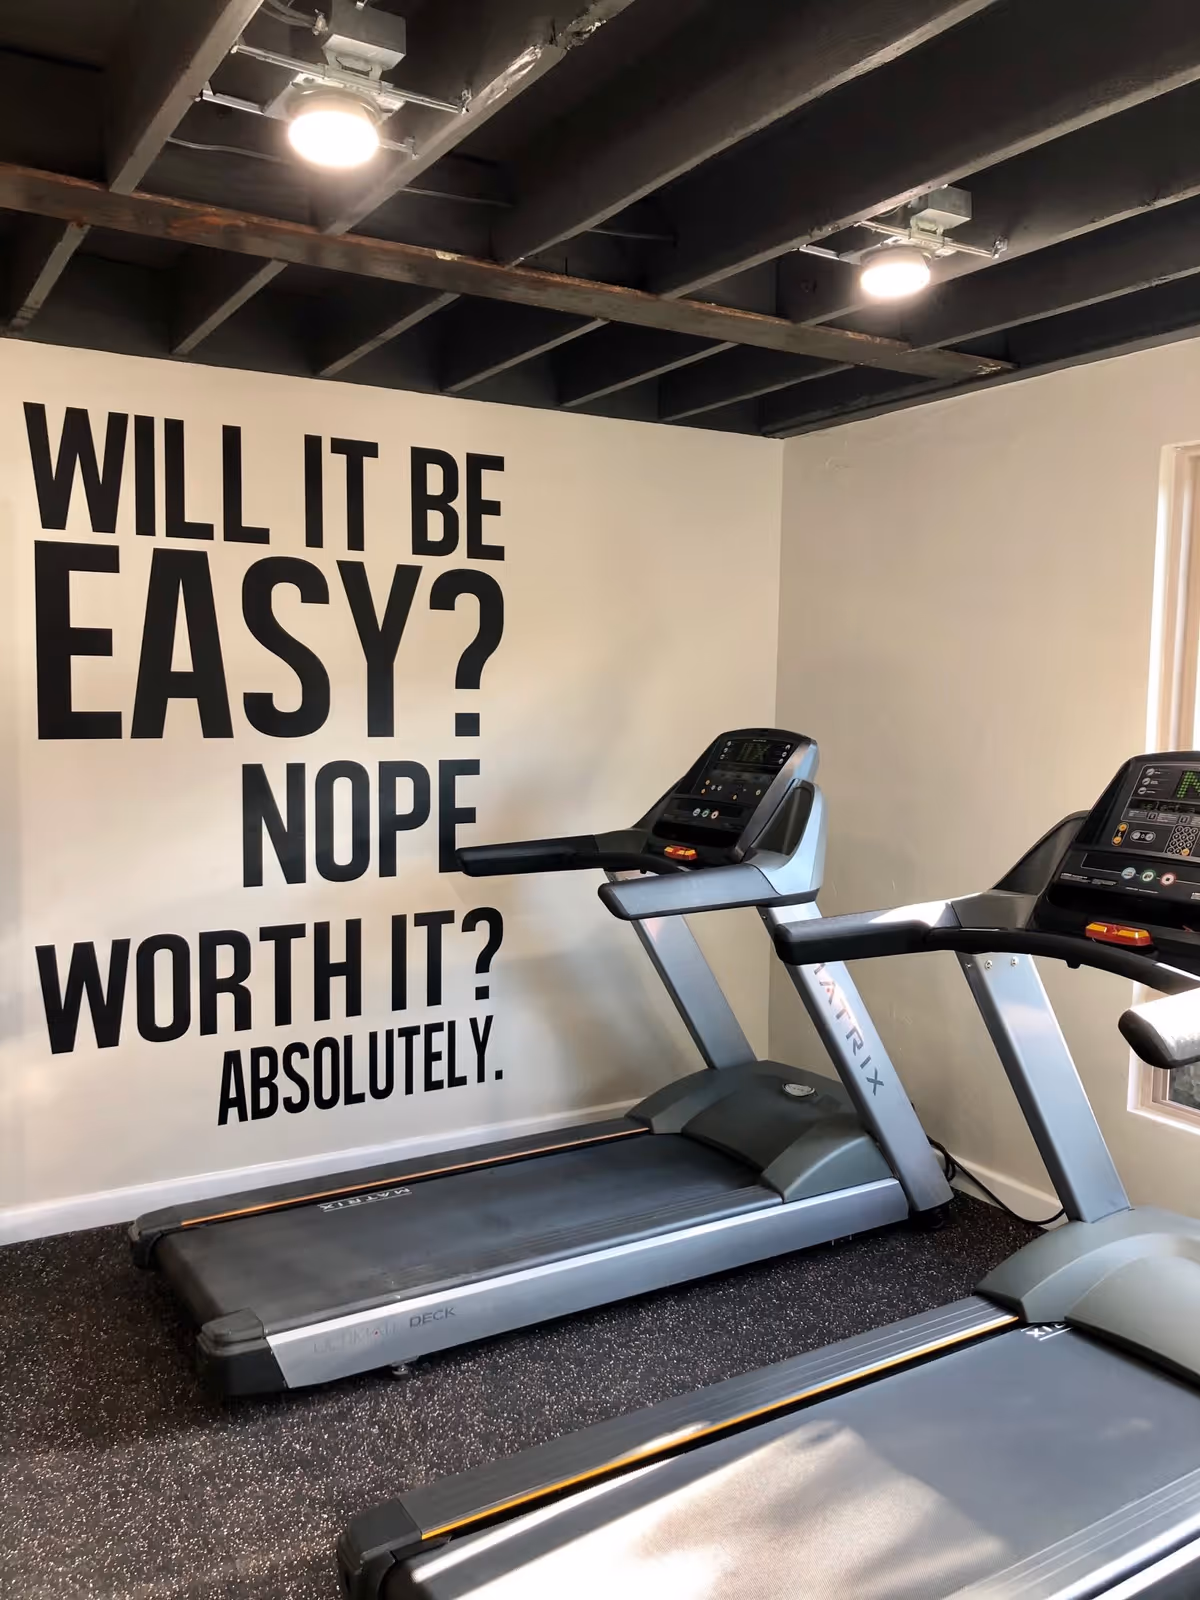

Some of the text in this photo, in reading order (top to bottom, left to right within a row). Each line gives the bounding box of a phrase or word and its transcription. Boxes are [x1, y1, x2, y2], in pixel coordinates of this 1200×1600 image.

[23, 402, 505, 561] WILL IT BE
[35, 540, 505, 740] EASY?
[242, 759, 480, 888] NOPE
[36, 906, 504, 1055] WORTH IT?
[217, 1015, 504, 1126] ABSOLUTELY.
[319, 1187, 411, 1210] MATRIX
[409, 1306, 457, 1329] DECK
